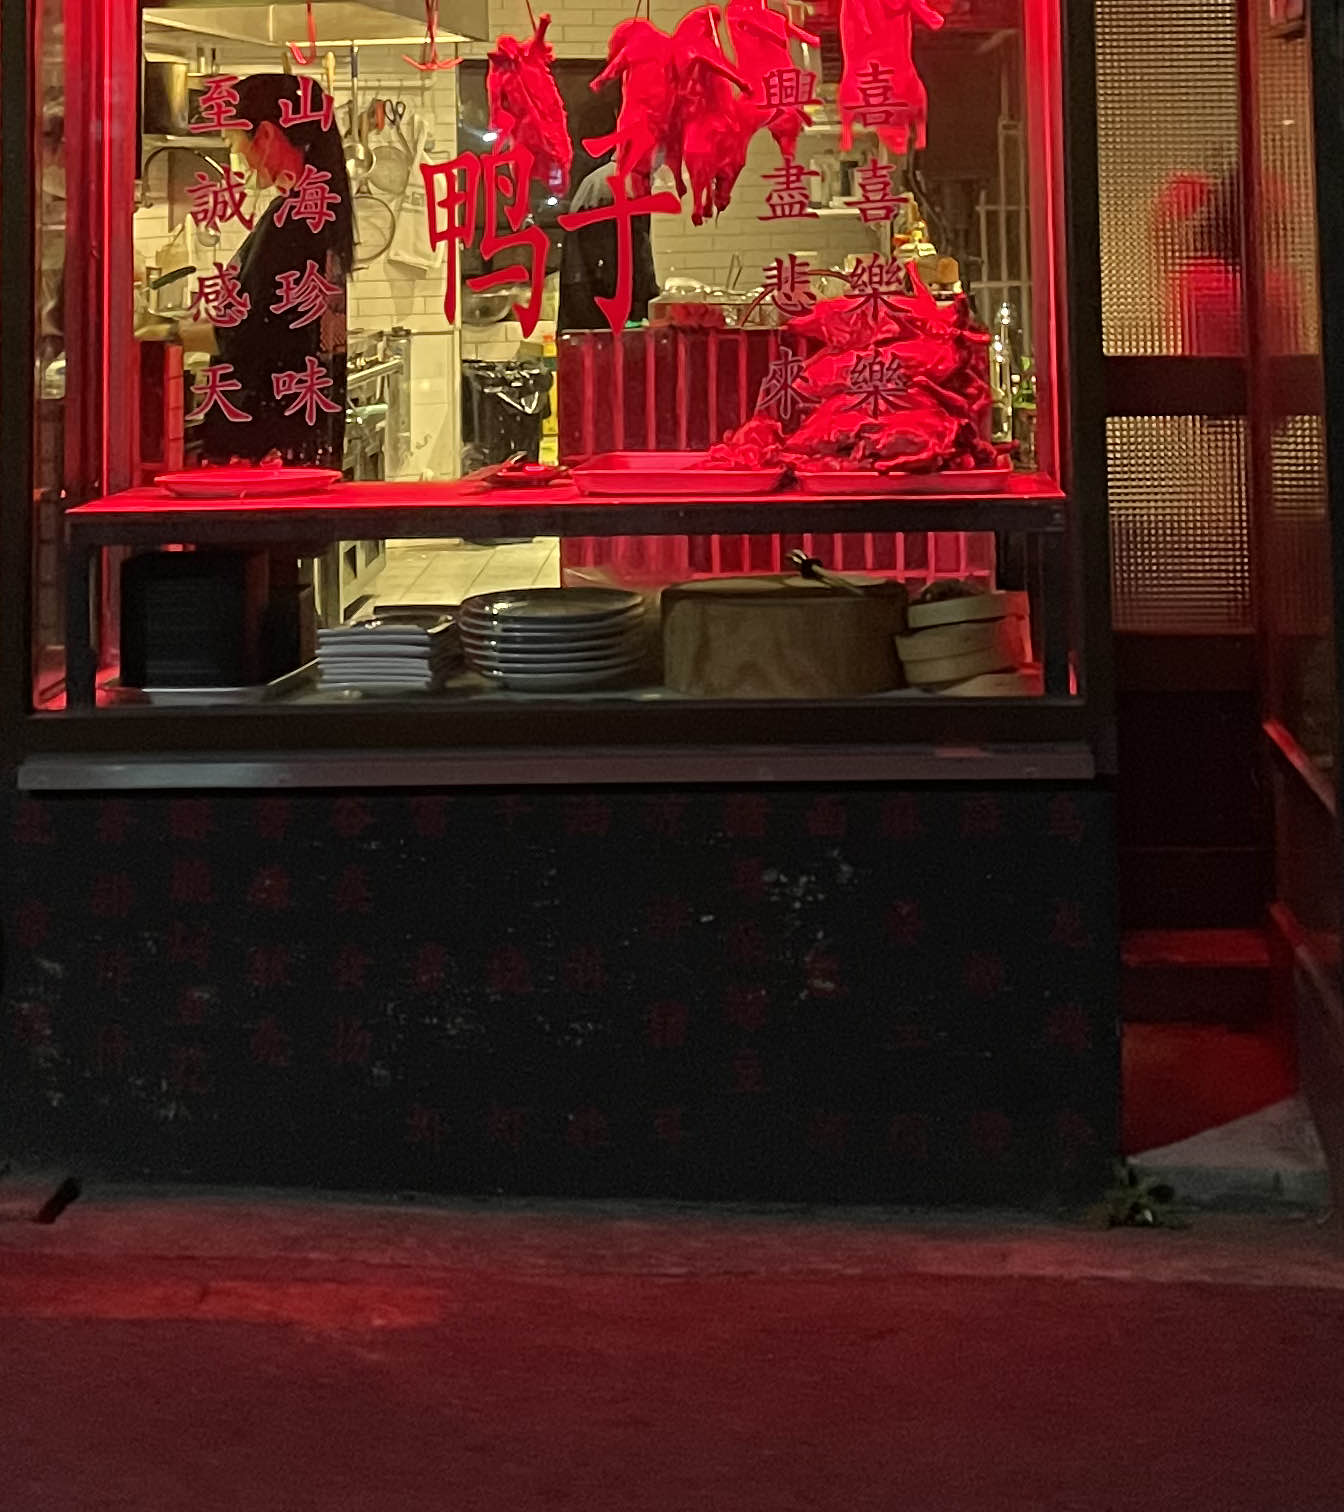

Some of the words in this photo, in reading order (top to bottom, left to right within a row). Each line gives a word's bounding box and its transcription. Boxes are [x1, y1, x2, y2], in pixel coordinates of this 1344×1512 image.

[184, 73, 254, 423] 至誠感天
[269, 73, 344, 426] 山海珍味
[843, 61, 914, 420] 喜喜樂樂
